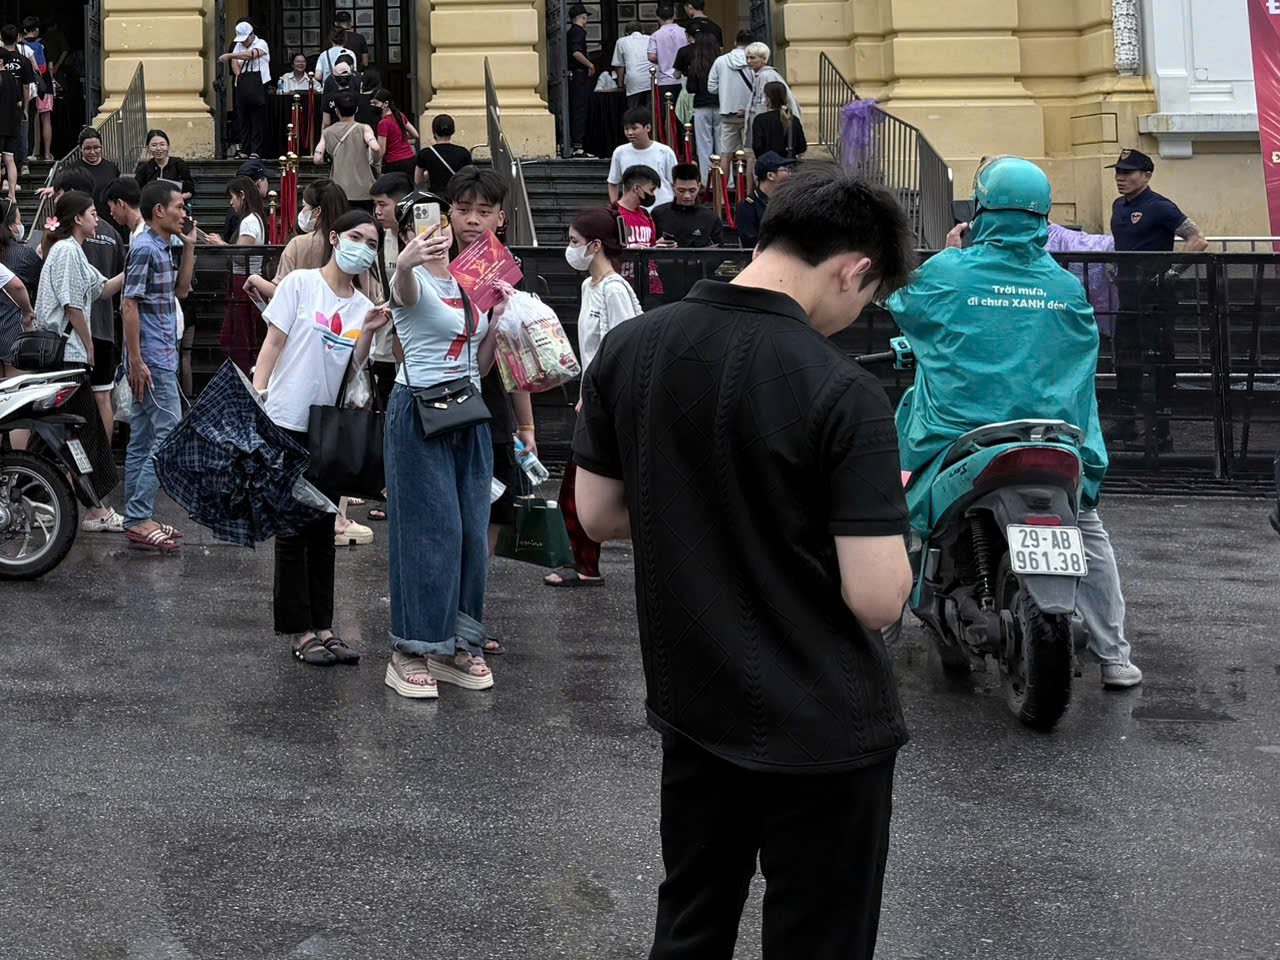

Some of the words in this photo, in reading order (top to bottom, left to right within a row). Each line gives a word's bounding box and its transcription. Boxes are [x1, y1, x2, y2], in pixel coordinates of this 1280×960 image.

[992, 285, 1016, 295] Trời
[1018, 287, 1047, 297] mưa,
[967, 296, 978, 306] đi
[981, 297, 1009, 307] chưa
[1012, 298, 1045, 309] XANH
[1018, 529, 1071, 549] 29-AB
[1016, 551, 1081, 572] 961.38
